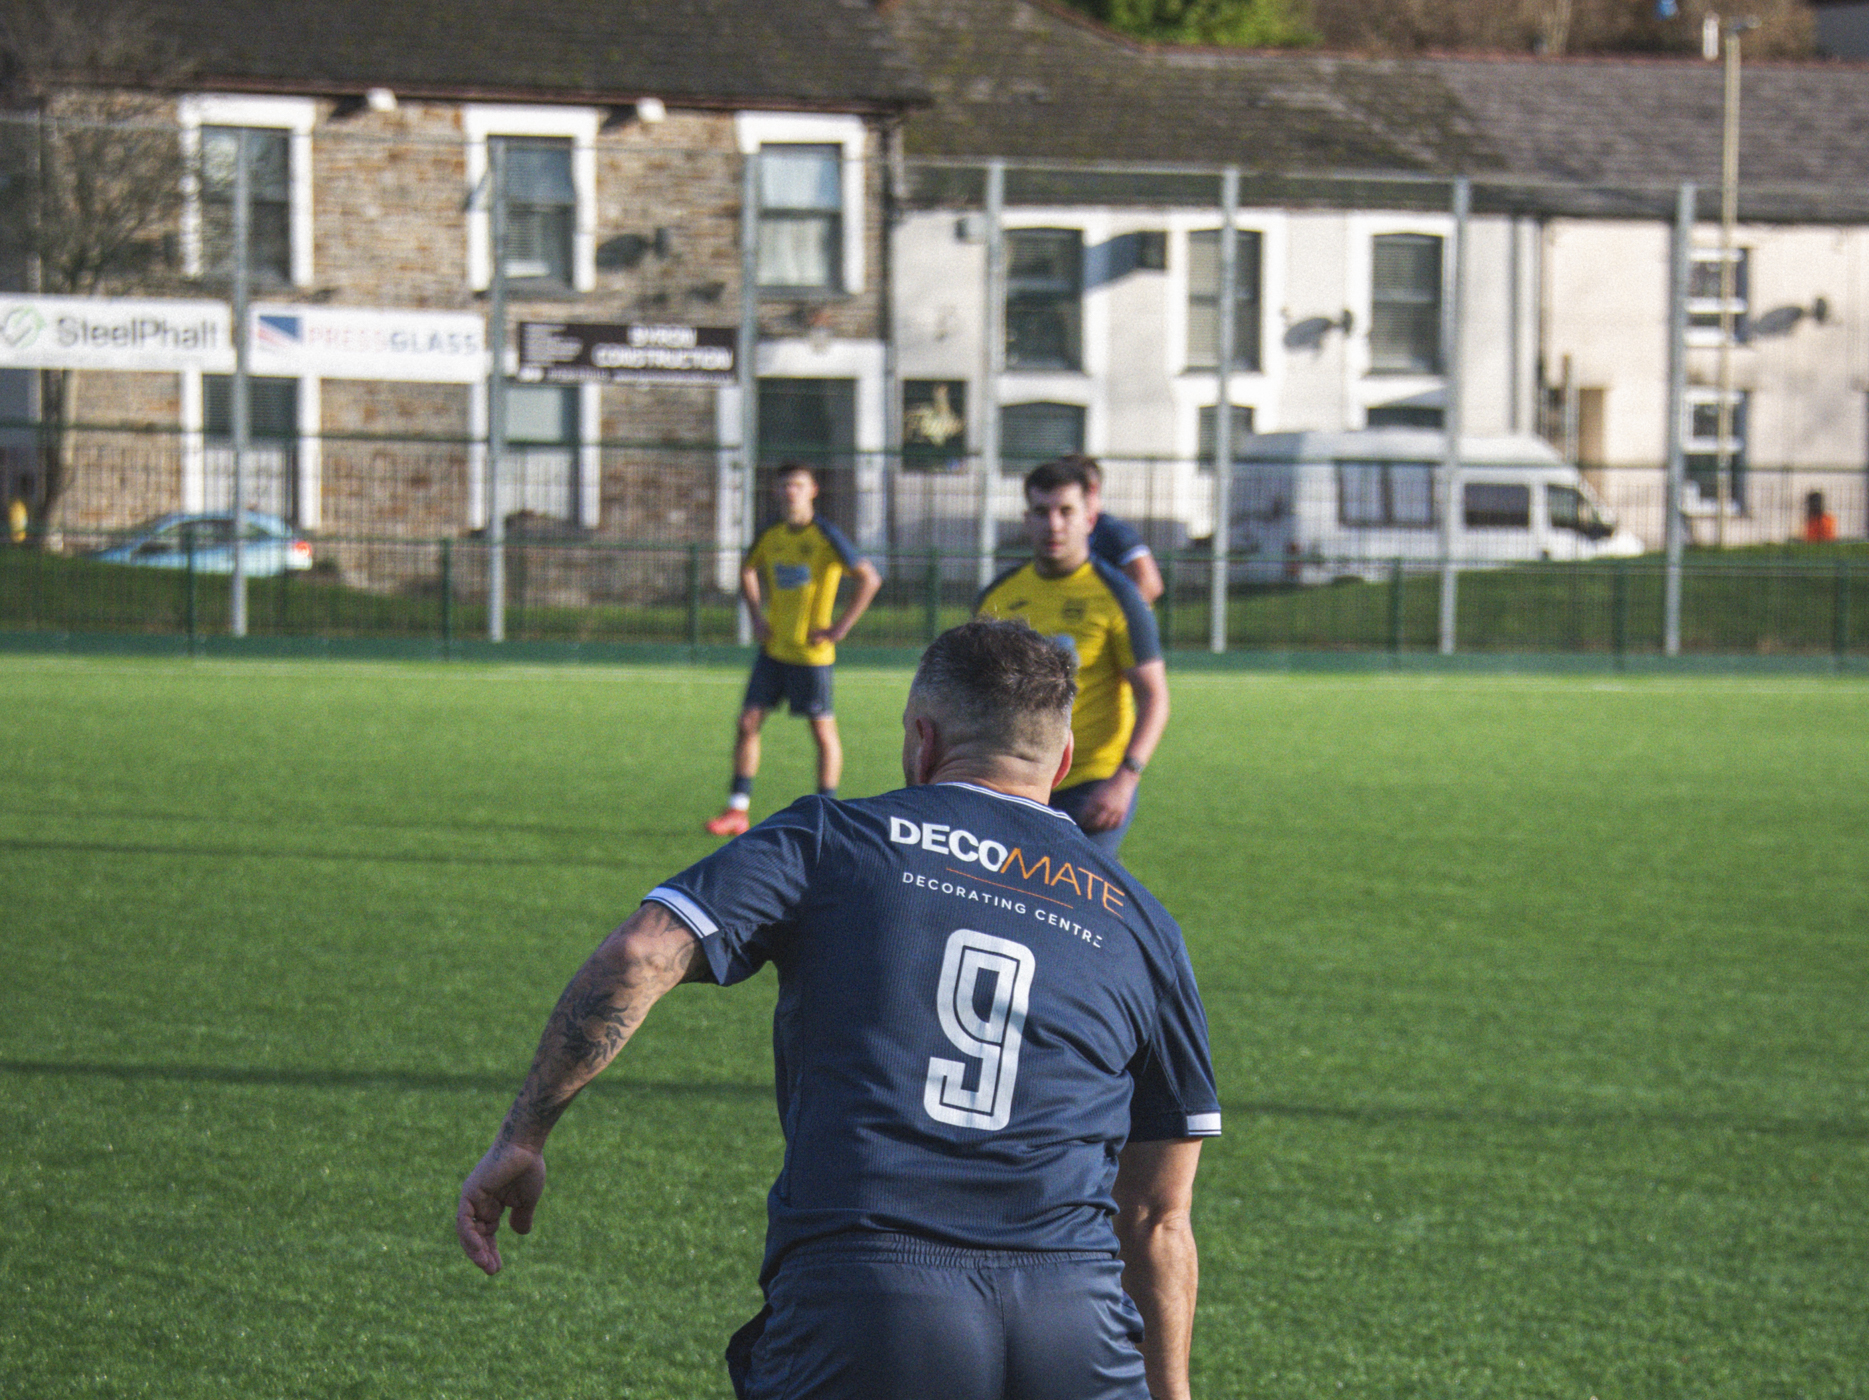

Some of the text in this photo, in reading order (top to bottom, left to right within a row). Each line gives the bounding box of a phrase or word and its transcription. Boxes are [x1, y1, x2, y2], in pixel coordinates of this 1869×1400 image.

[57, 314, 217, 347] SteelPhalt
[890, 816, 1125, 919] DECOMATE
[903, 872, 1027, 914] DECORATING
[923, 928, 1036, 1131] 9
